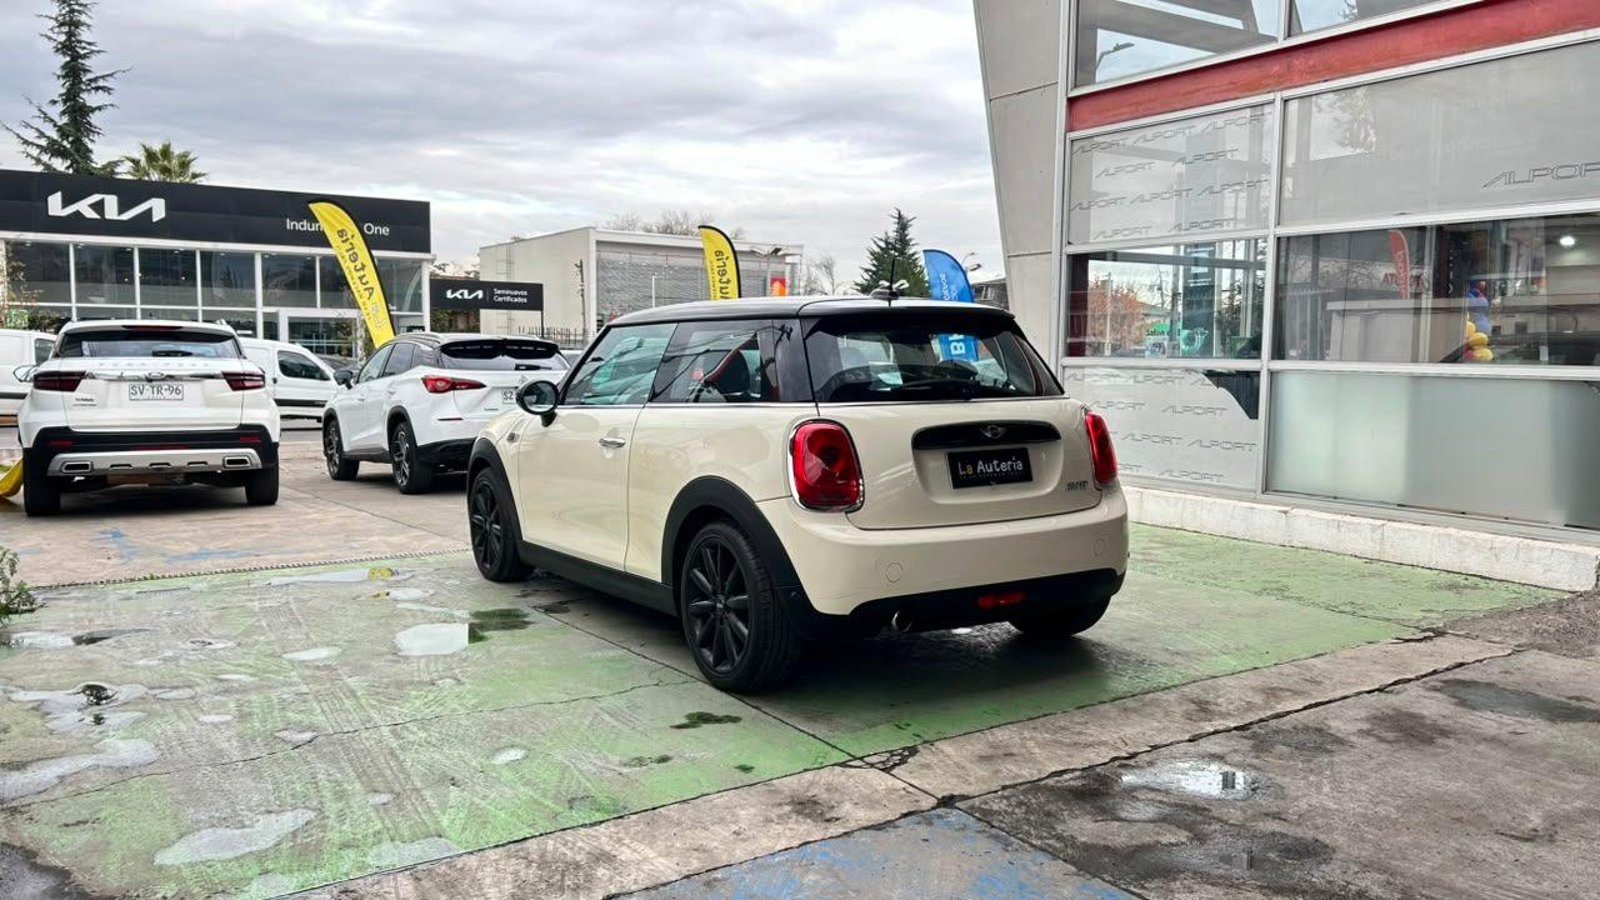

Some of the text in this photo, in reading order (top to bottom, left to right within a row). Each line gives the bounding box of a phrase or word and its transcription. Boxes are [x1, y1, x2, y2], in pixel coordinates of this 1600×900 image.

[1134, 126, 1196, 143] ALPORT
[1096, 147, 1239, 178] ALPORT ALPORT
[47, 190, 166, 223] KIA
[1070, 197, 1127, 211] ALPORT
[1130, 188, 1193, 204] ALPORT
[363, 223, 390, 236] One
[1095, 217, 1236, 240] ALPORT ALPORT
[446, 289, 484, 300] KIA
[1161, 403, 1228, 416] ALPORT
[1121, 432, 1183, 445] ALPORT
[1188, 438, 1257, 452] ALPORT
[957, 461, 974, 476] La
[976, 456, 1024, 474] Auteria
[1159, 468, 1225, 482] ALPORT
